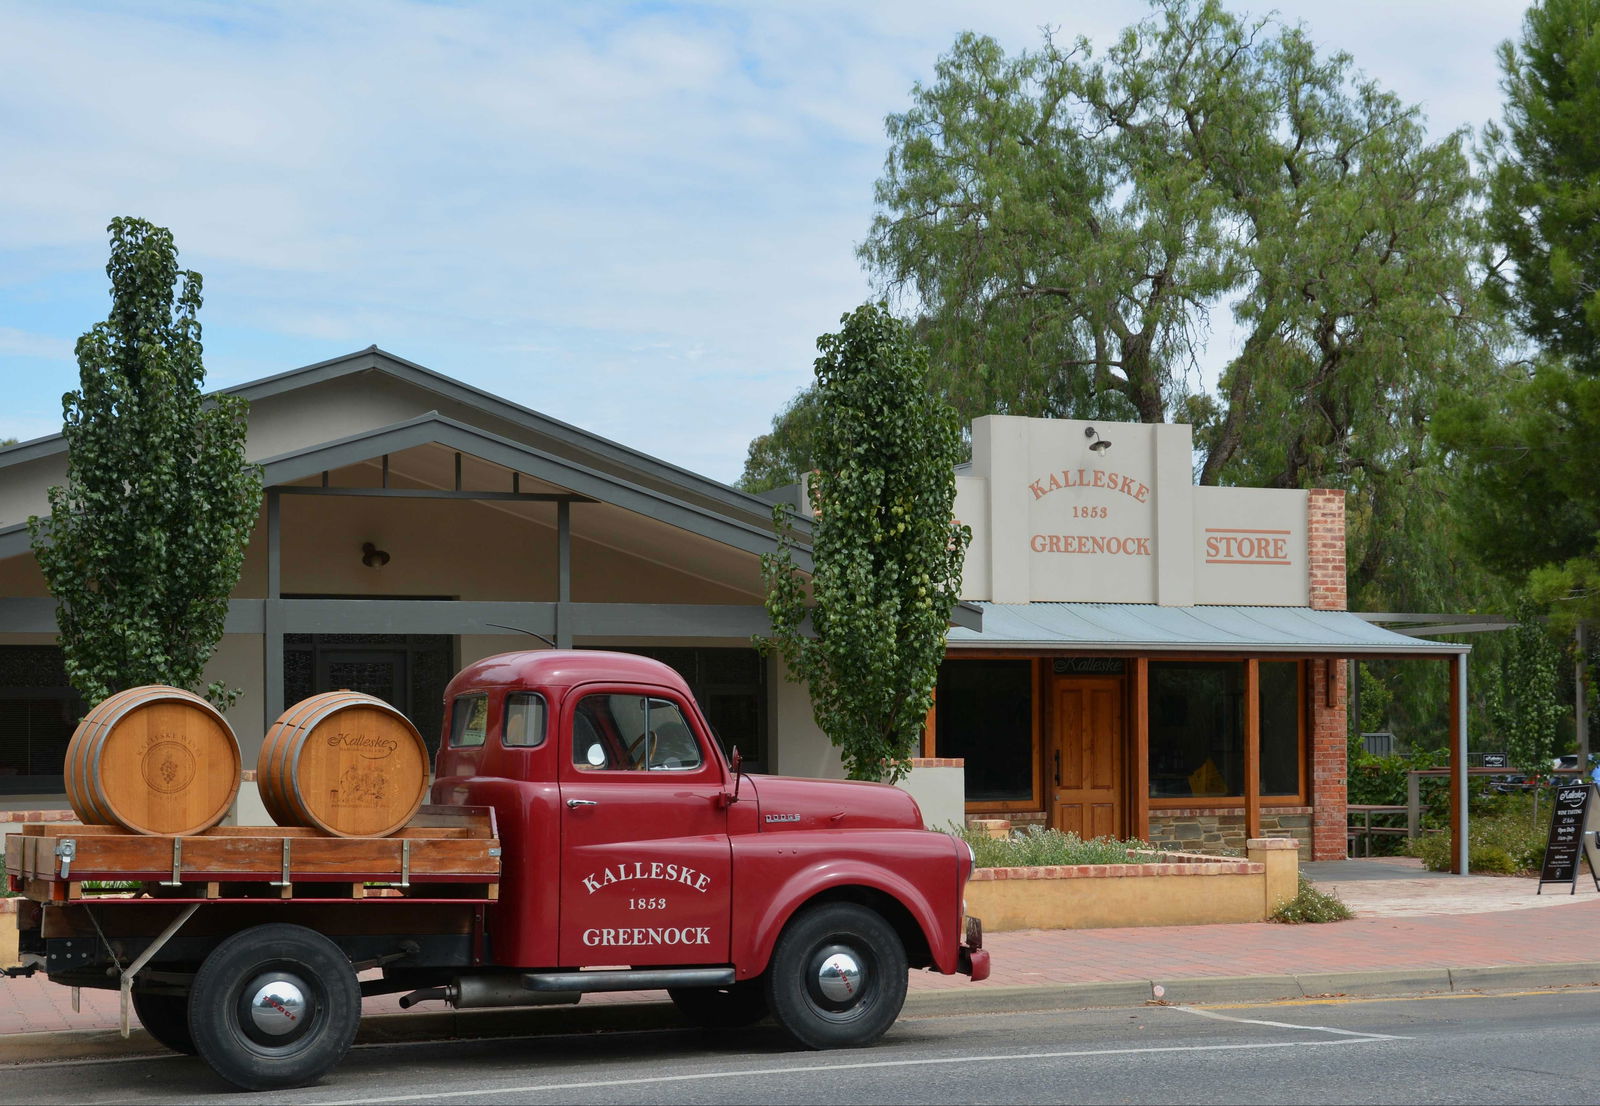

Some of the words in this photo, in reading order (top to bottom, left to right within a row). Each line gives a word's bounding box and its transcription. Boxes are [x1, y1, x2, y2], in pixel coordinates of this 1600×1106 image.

[1028, 469, 1150, 503] KALLESKE
[1073, 506, 1108, 519] 1853
[1030, 534, 1151, 556] GREENOCK
[1206, 536, 1288, 559] STORE
[327, 733, 397, 753] Kalleske
[765, 814, 801, 823] DODGE
[582, 862, 711, 895] KALLESKE
[629, 898, 667, 910] 1853
[582, 927, 711, 946] GREENOCK
